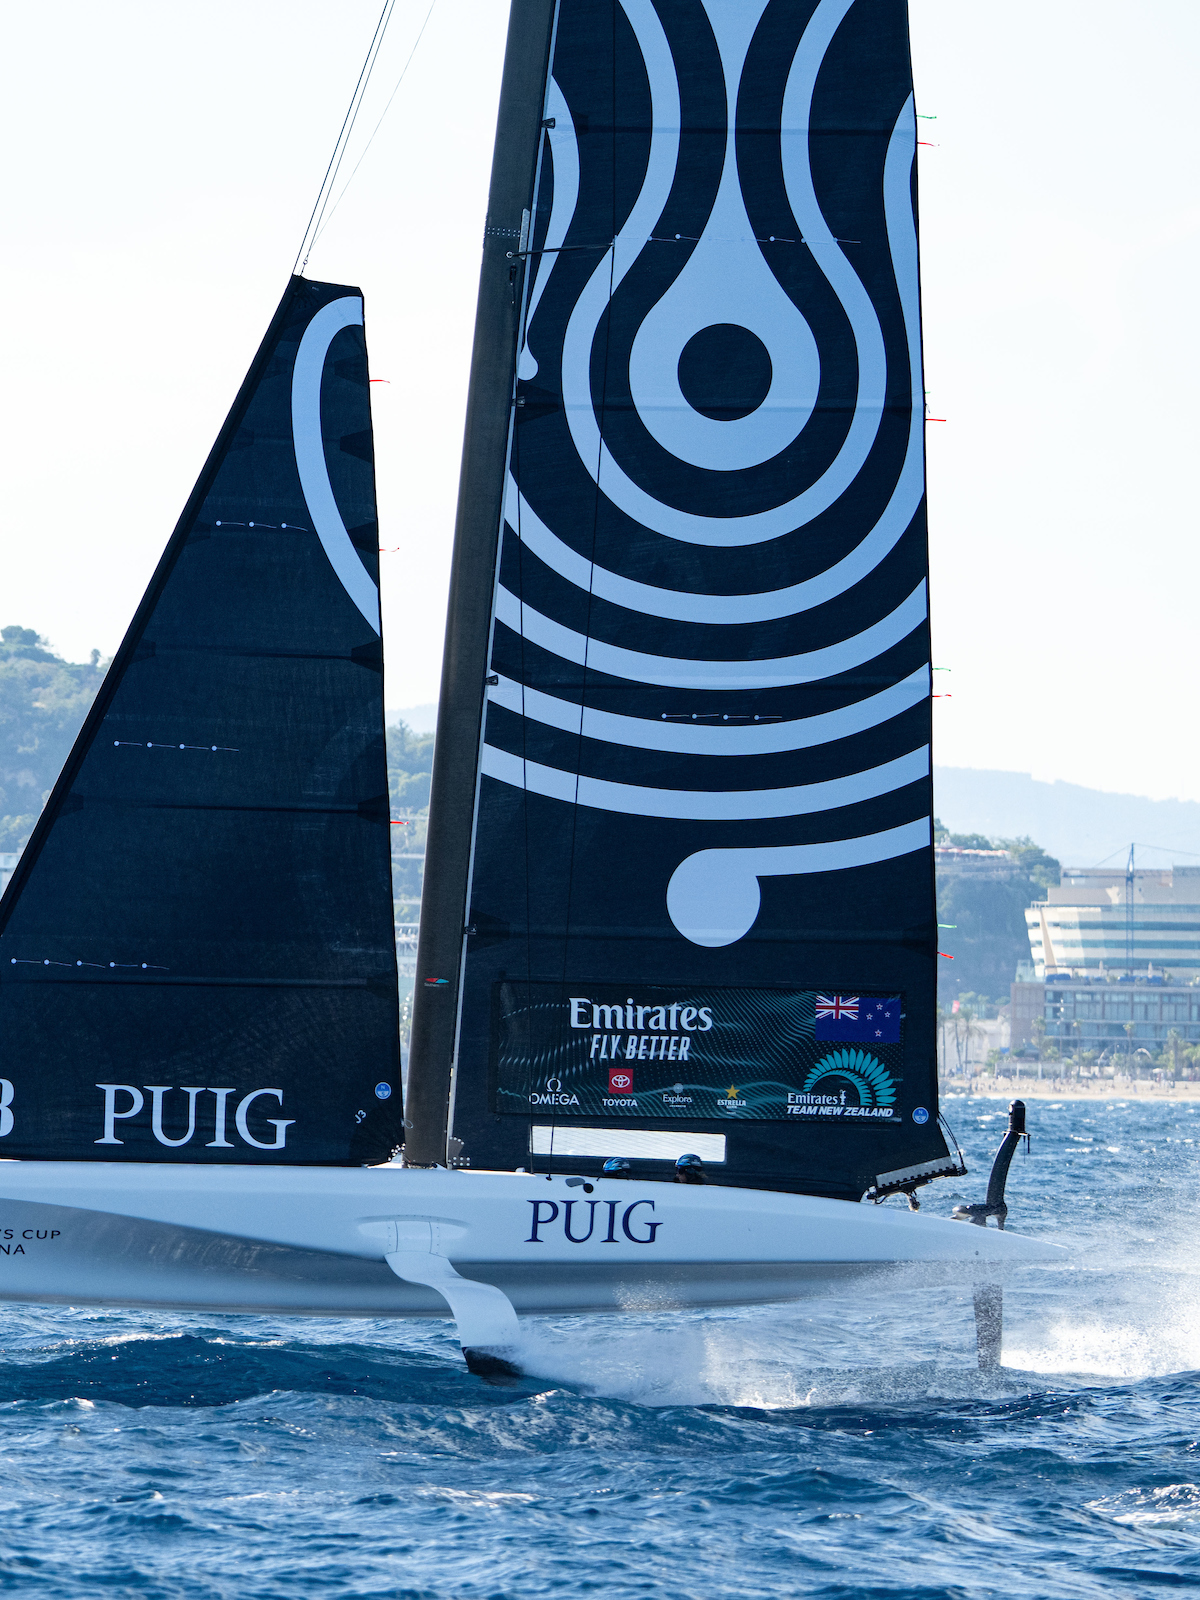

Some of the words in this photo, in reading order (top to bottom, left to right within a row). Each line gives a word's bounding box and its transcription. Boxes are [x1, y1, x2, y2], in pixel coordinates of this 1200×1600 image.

[569, 997, 713, 1031] Emirates
[589, 1034, 621, 1060] FLY
[625, 1035, 691, 1061] BETTER
[528, 1092, 580, 1106] OMEGA
[602, 1098, 638, 1107] TOYOTA
[662, 1094, 692, 1104] Explora
[787, 1092, 838, 1105] Emirates
[94, 1083, 297, 1150] PUIG
[354, 1109, 367, 1124] J3
[786, 1105, 820, 1115] TEAM
[818, 1105, 844, 1116] NEW
[844, 1106, 894, 1117] ZEALAND
[524, 1199, 664, 1244] PUIG
[22, 1229, 61, 1240] CUP
